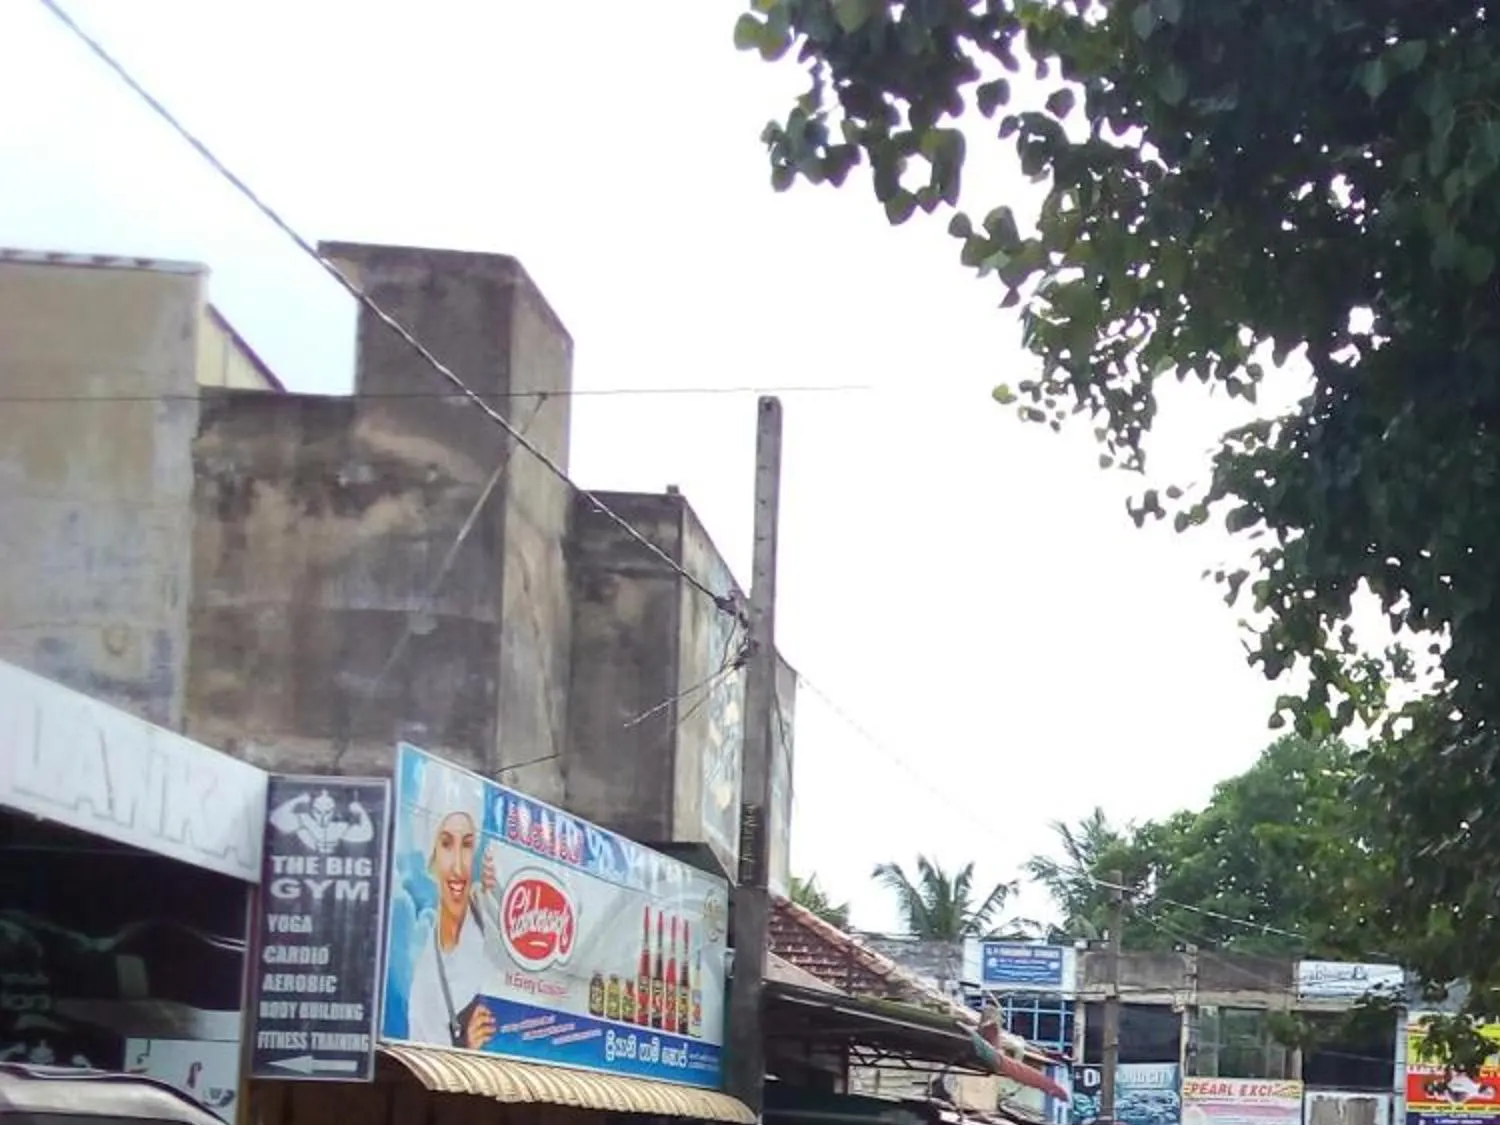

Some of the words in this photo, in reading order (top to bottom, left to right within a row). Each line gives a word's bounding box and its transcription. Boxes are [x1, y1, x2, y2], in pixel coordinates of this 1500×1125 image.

[271, 856, 320, 874] THE
[326, 857, 372, 876] BIG
[270, 878, 370, 901] GYM
[266, 914, 313, 933] YOGA
[262, 946, 329, 965] CARDIO
[262, 974, 338, 993] AEROBIC
[259, 1001, 298, 1019] BODY
[299, 1002, 364, 1020] BUILDING
[257, 1031, 308, 1049] FITNESS
[310, 1032, 370, 1052] TRAINING
